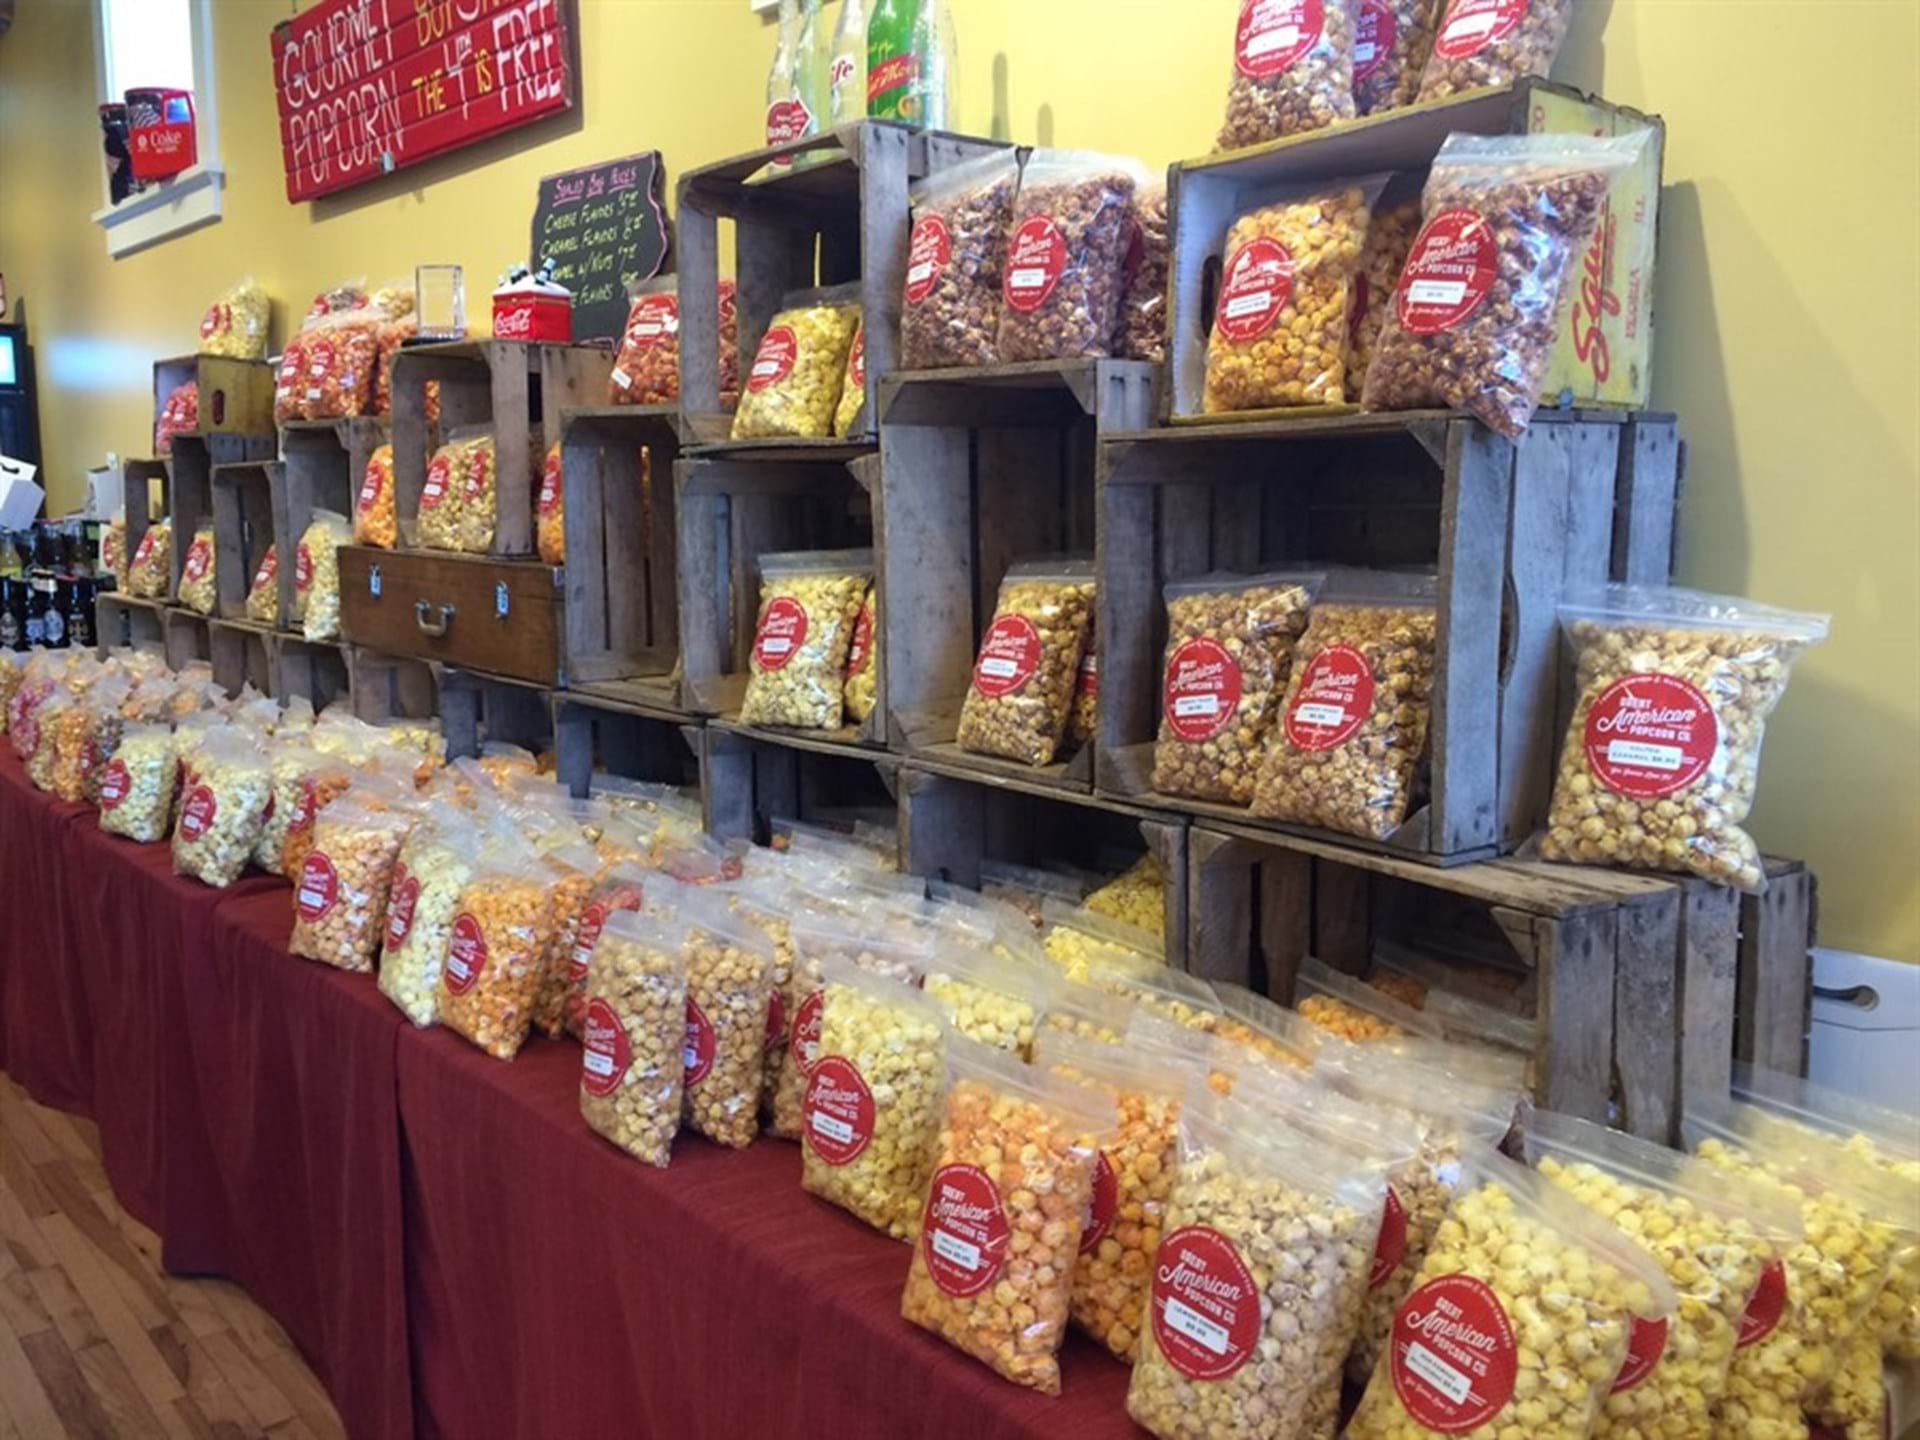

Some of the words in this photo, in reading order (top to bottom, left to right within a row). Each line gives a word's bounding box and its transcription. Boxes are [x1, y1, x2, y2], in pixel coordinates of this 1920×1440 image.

[282, 0, 394, 108] GOURMET
[411, 69, 448, 118] THE
[475, 49, 493, 95] IS
[492, 0, 563, 112] FREE
[150, 129, 182, 148] Coke
[289, 71, 404, 191] POPCORN
[1624, 268, 1642, 340] PEORIA
[1596, 706, 1697, 733] American
[1629, 725, 1675, 740] POPCORN
[931, 1197, 992, 1223] American
[1158, 1262, 1242, 1301] American
[1183, 1286, 1223, 1317] POPCORN
[1406, 1309, 1498, 1353] American
[1432, 1333, 1473, 1367] POPCORN
